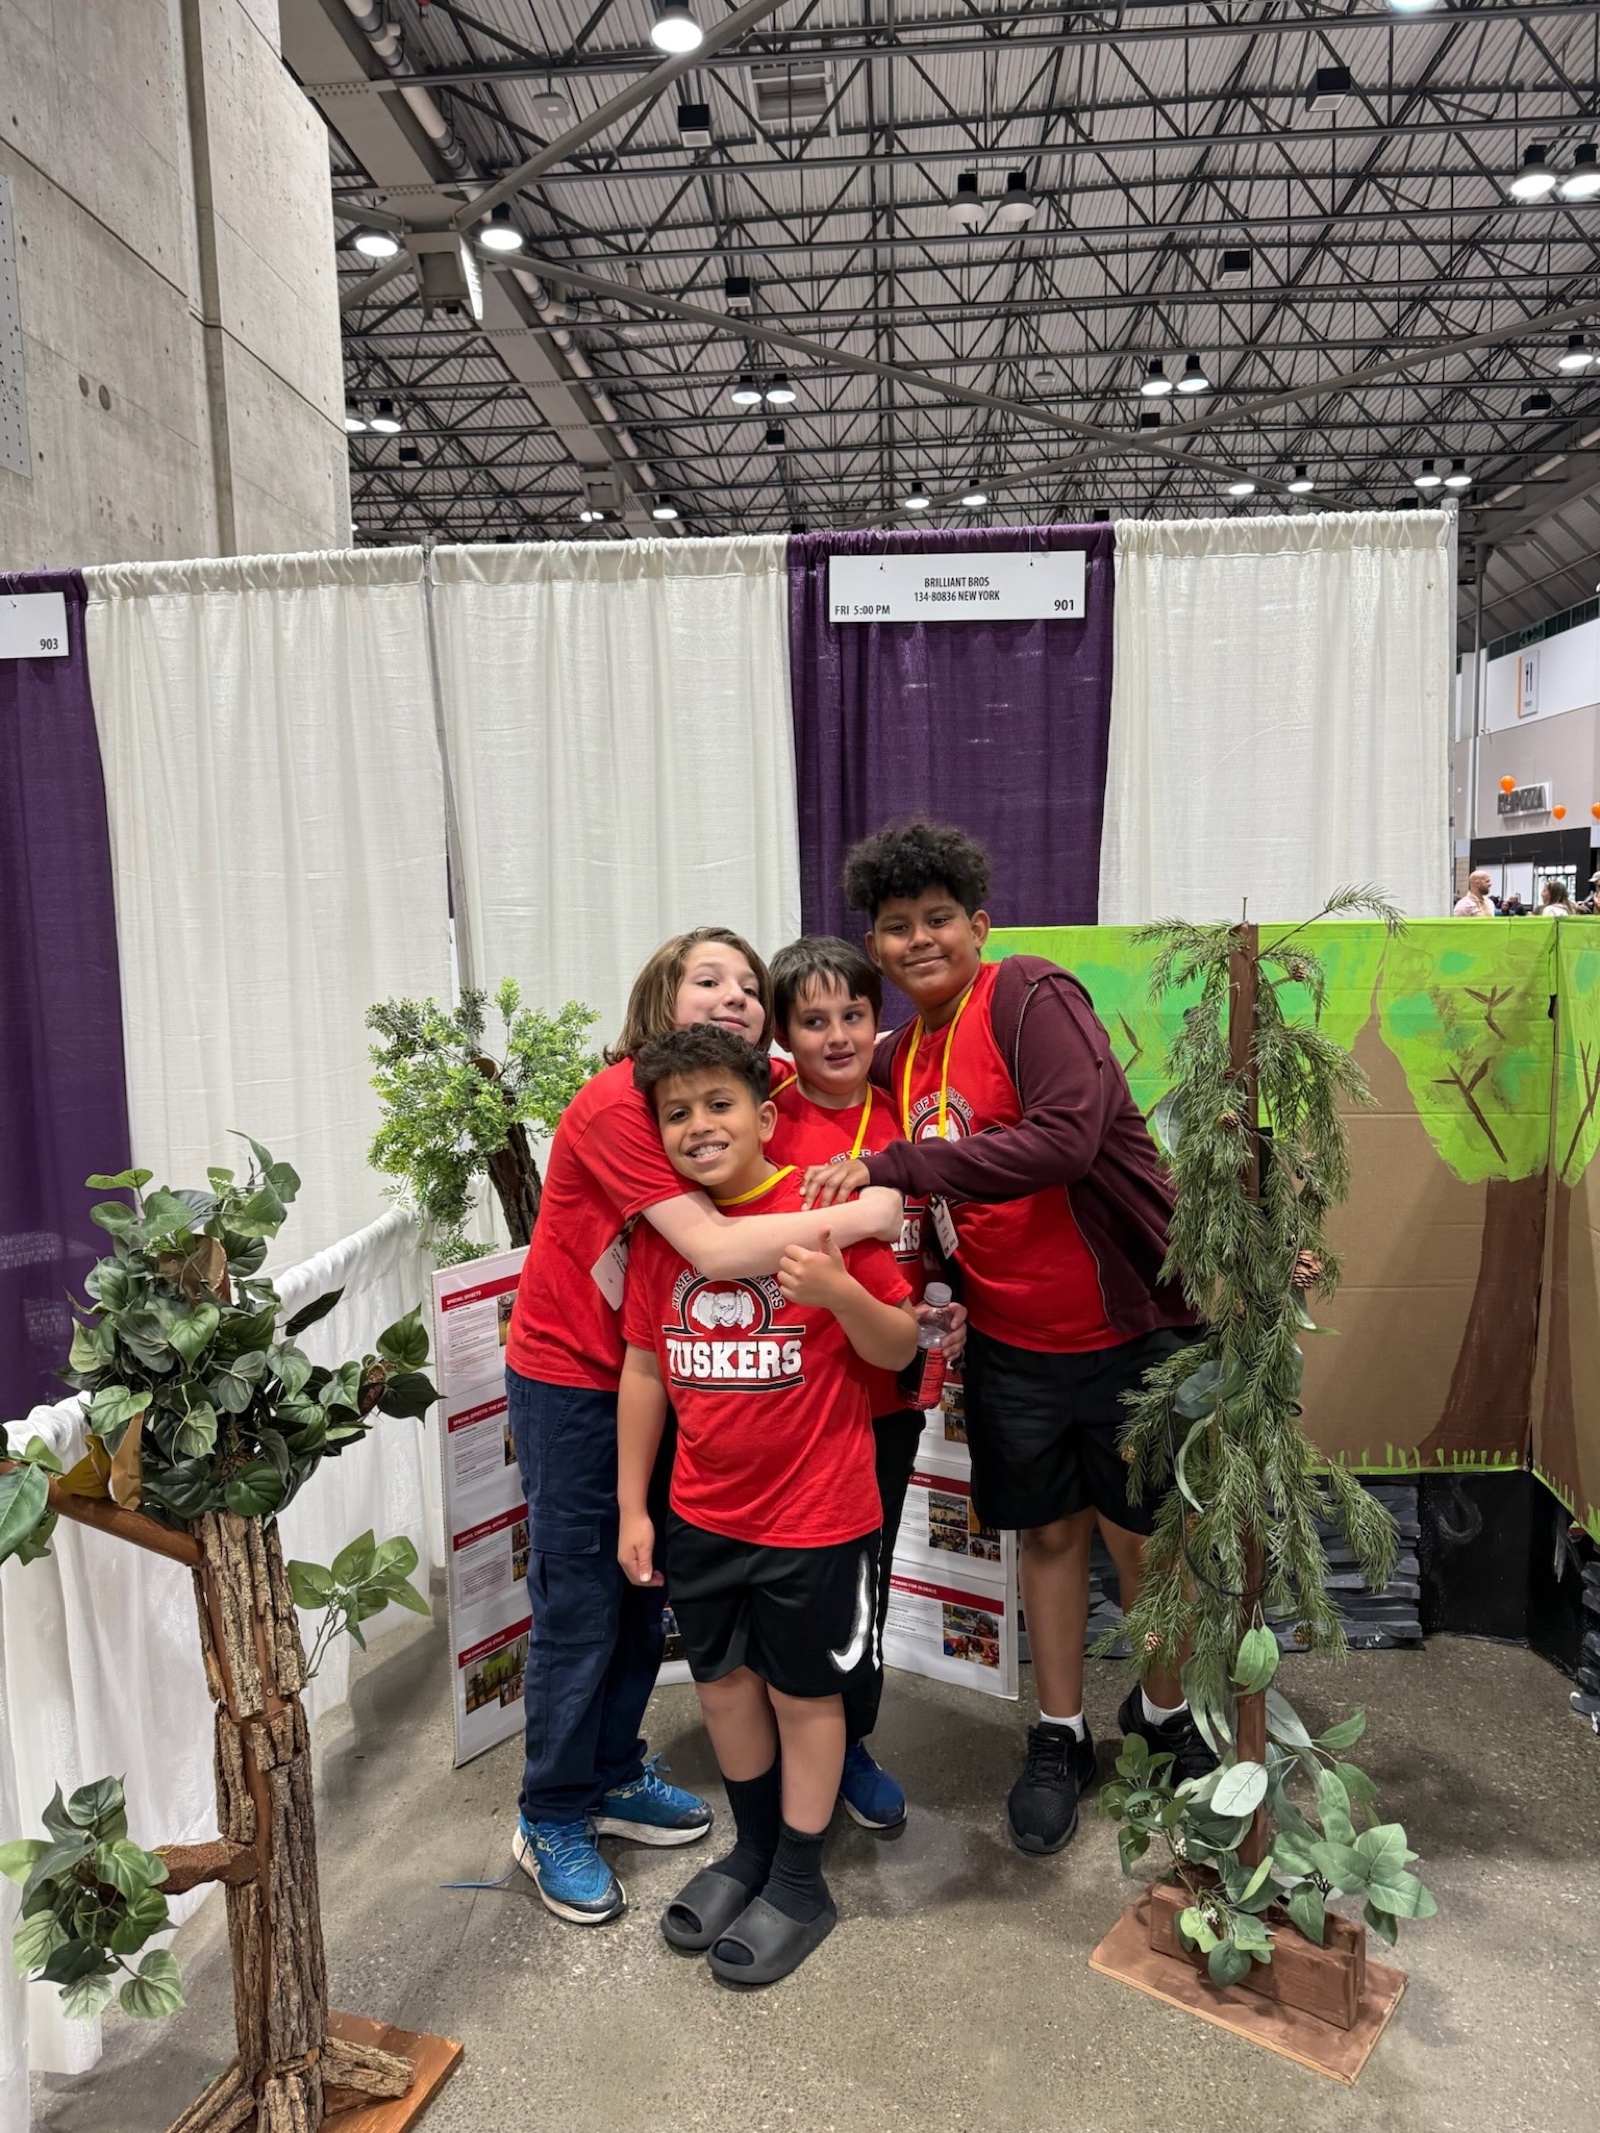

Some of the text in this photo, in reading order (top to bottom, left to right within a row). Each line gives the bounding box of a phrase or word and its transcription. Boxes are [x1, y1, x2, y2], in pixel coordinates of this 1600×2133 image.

[924, 576, 990, 588] BRILLIANT BROS
[914, 590, 1000, 602] 134-80836 NEW YORK
[834, 604, 891, 615] FRI 5:00 PM
[1054, 599, 1074, 611] 901
[40, 638, 58, 650] 903
[671, 1269, 694, 1310] HOME
[666, 1338, 802, 1379] TUSKERS
